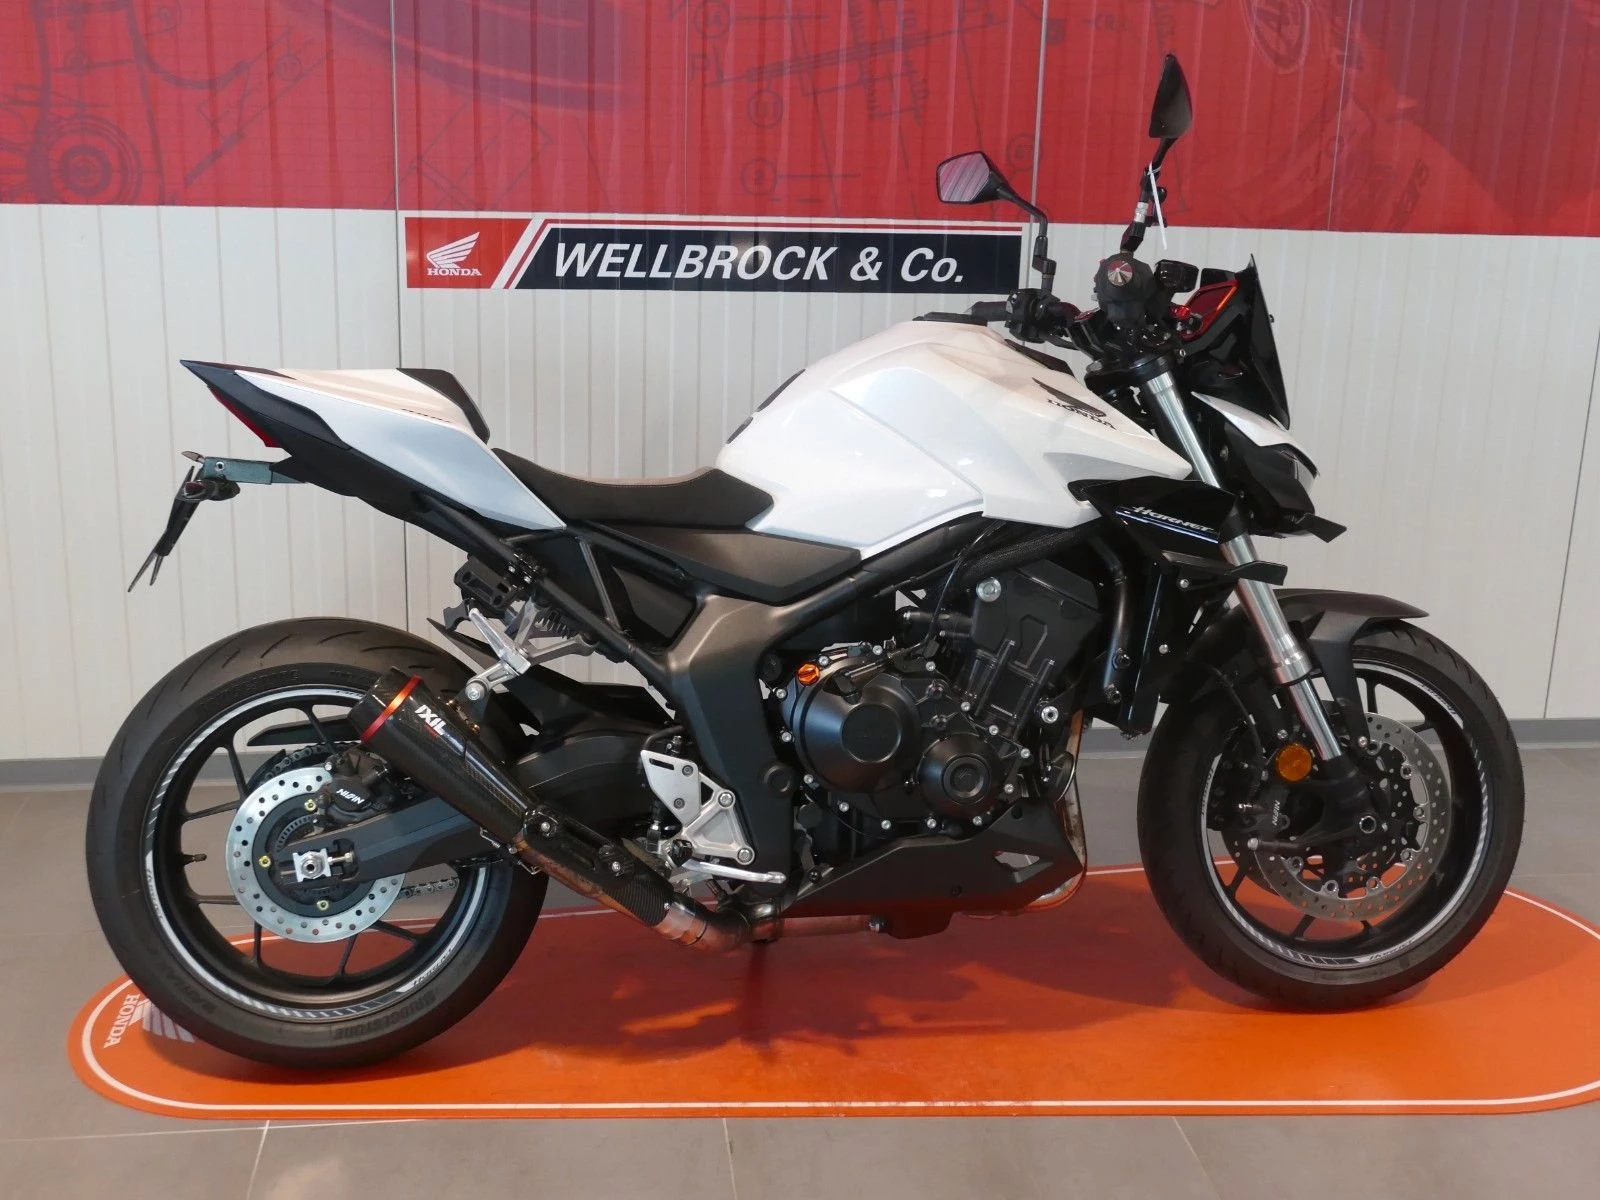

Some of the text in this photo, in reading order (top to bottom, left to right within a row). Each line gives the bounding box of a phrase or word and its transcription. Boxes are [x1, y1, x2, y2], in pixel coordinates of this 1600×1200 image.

[426, 268, 483, 276] HONDA
[555, 242, 964, 283] WELLBROCK & Co.
[1047, 398, 1117, 431] HONDA
[414, 704, 447, 736] IXIL
[103, 993, 141, 1049] HONDA
